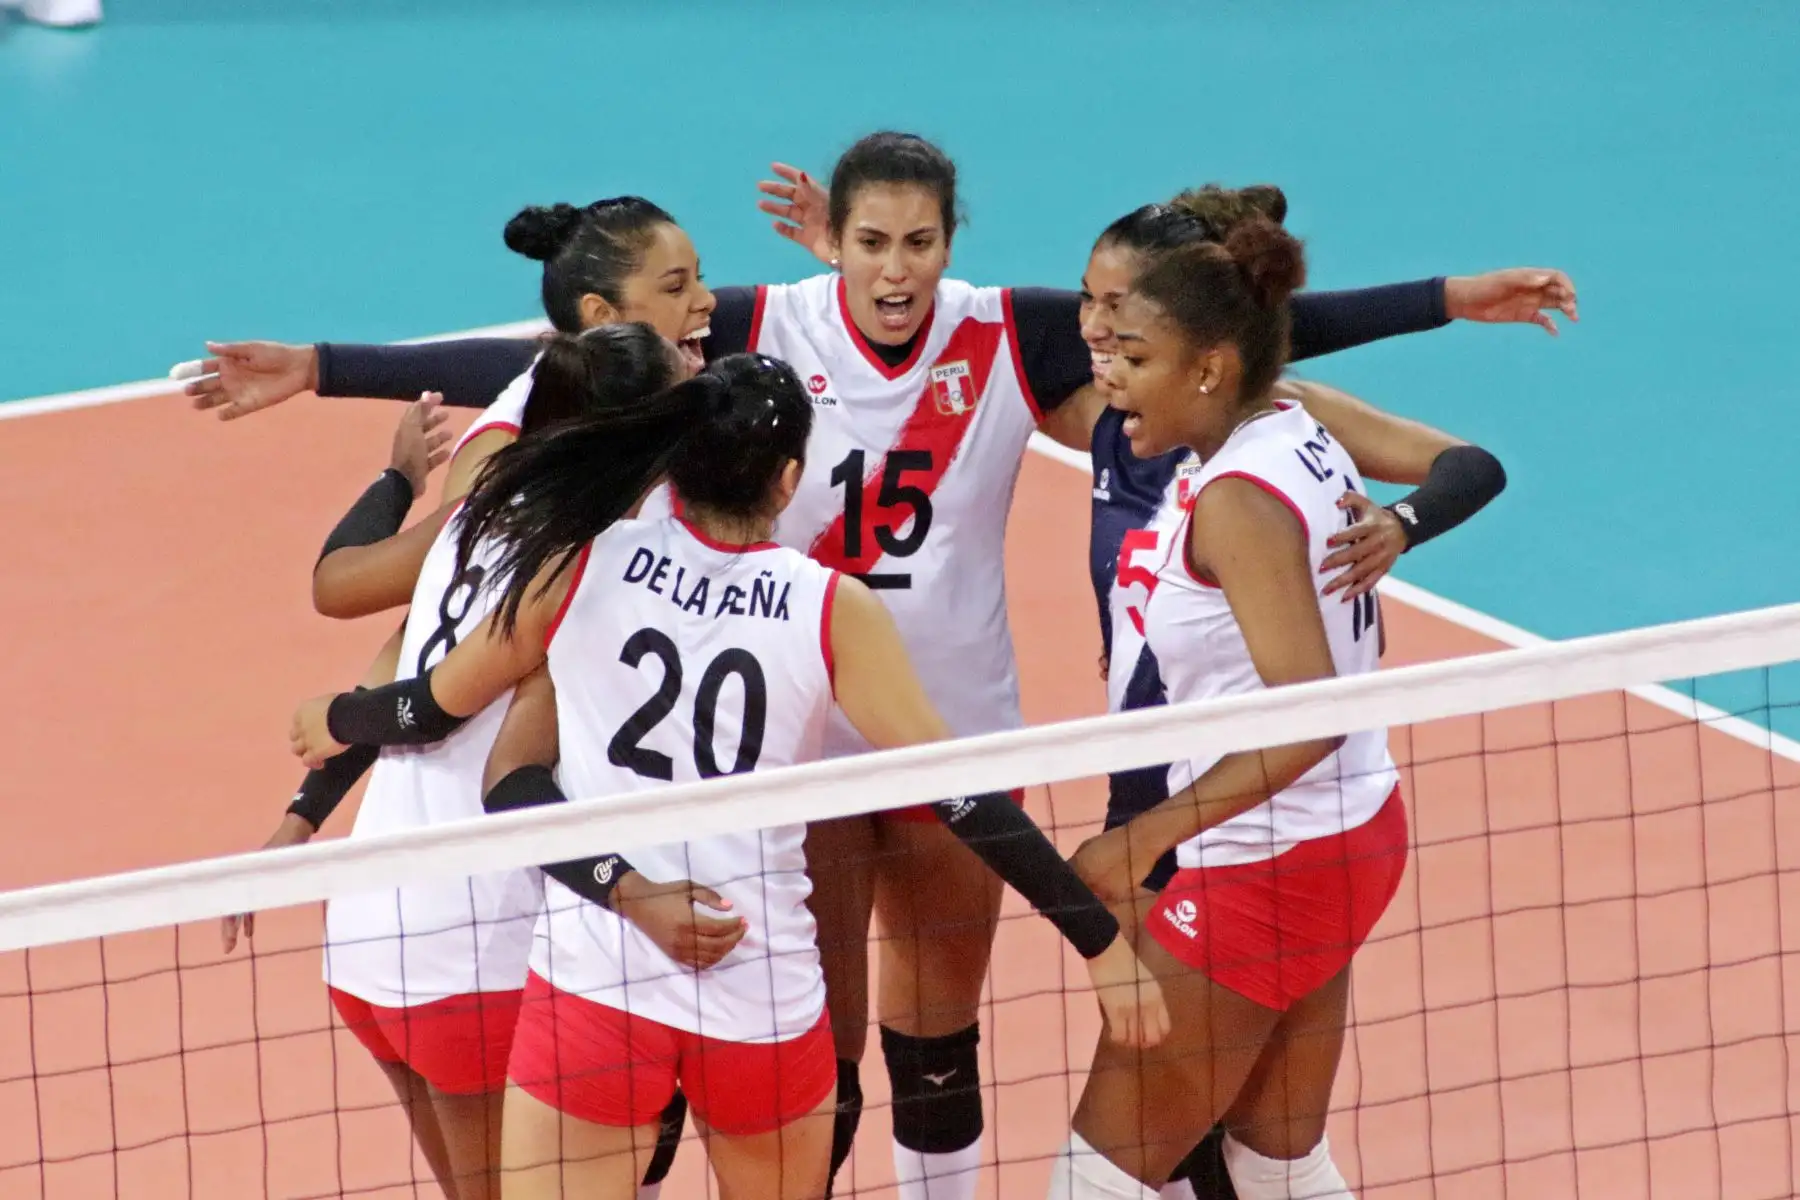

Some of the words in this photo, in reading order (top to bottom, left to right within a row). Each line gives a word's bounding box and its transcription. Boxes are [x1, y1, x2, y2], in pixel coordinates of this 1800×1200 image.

[935, 366, 965, 379] PERU
[1182, 467, 1201, 476] PER
[830, 448, 934, 558] 15
[622, 546, 672, 596] DE
[671, 566, 710, 616] LA
[608, 627, 768, 782] 20
[1163, 907, 1198, 939] WALON
